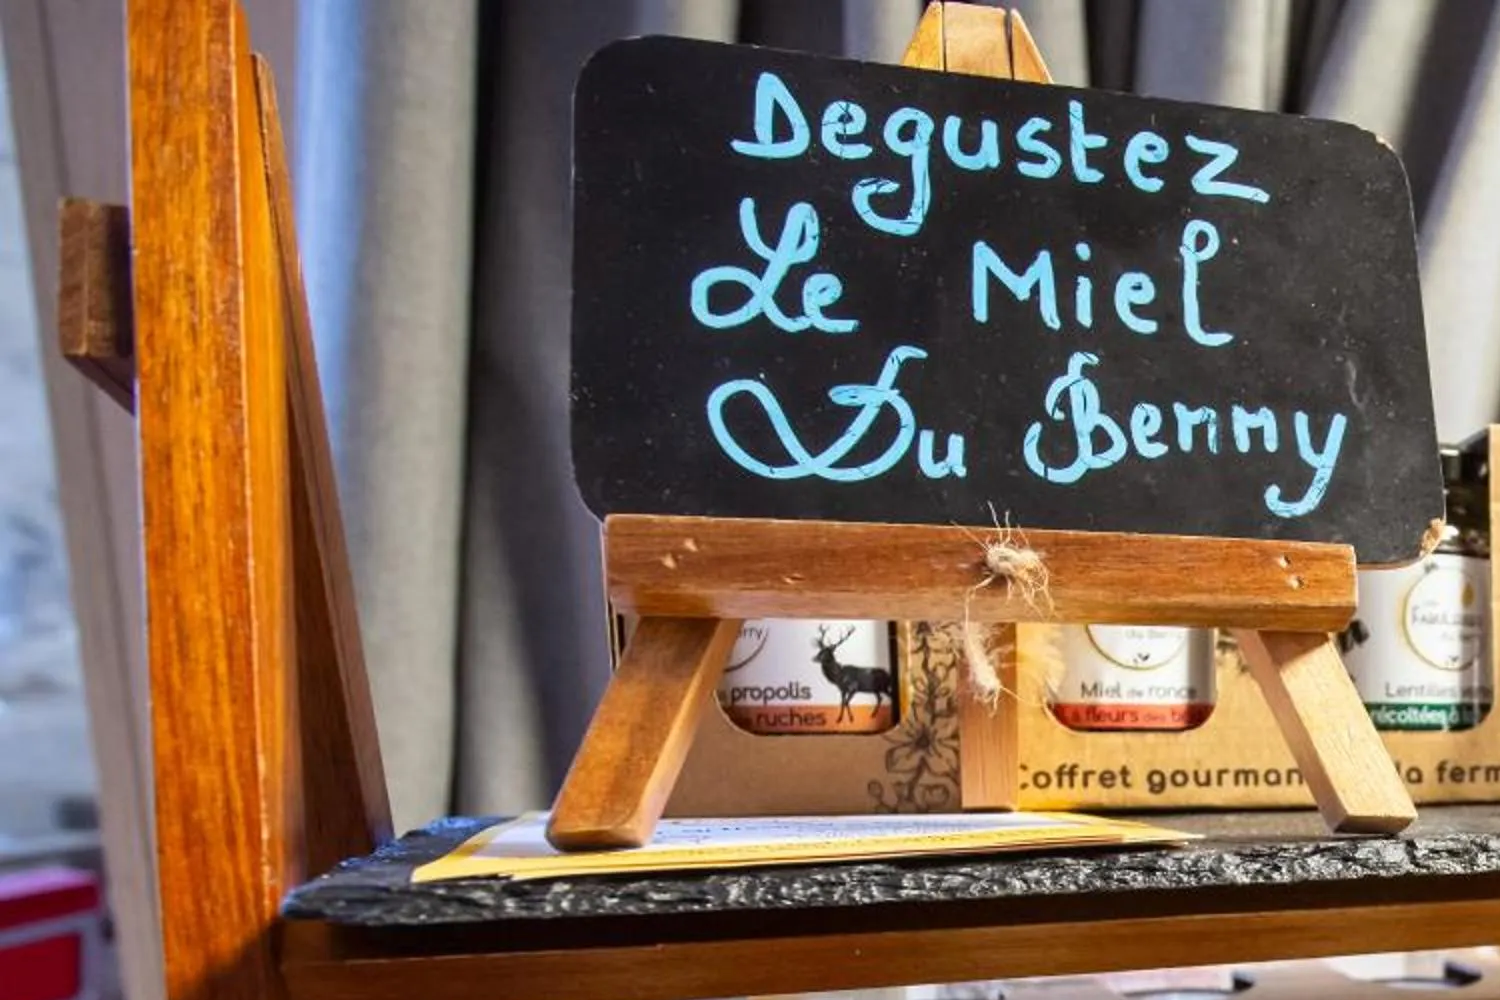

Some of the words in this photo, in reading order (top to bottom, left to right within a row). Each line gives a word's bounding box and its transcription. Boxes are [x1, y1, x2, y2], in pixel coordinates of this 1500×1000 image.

[732, 70, 1270, 236] Degustez
[691, 197, 858, 333] Le
[971, 220, 1233, 346] Miel
[707, 346, 967, 483] Du
[731, 681, 812, 705] propolis
[1080, 680, 1121, 700] Miel
[756, 707, 827, 727] ruches
[1146, 767, 1304, 794] gourman
